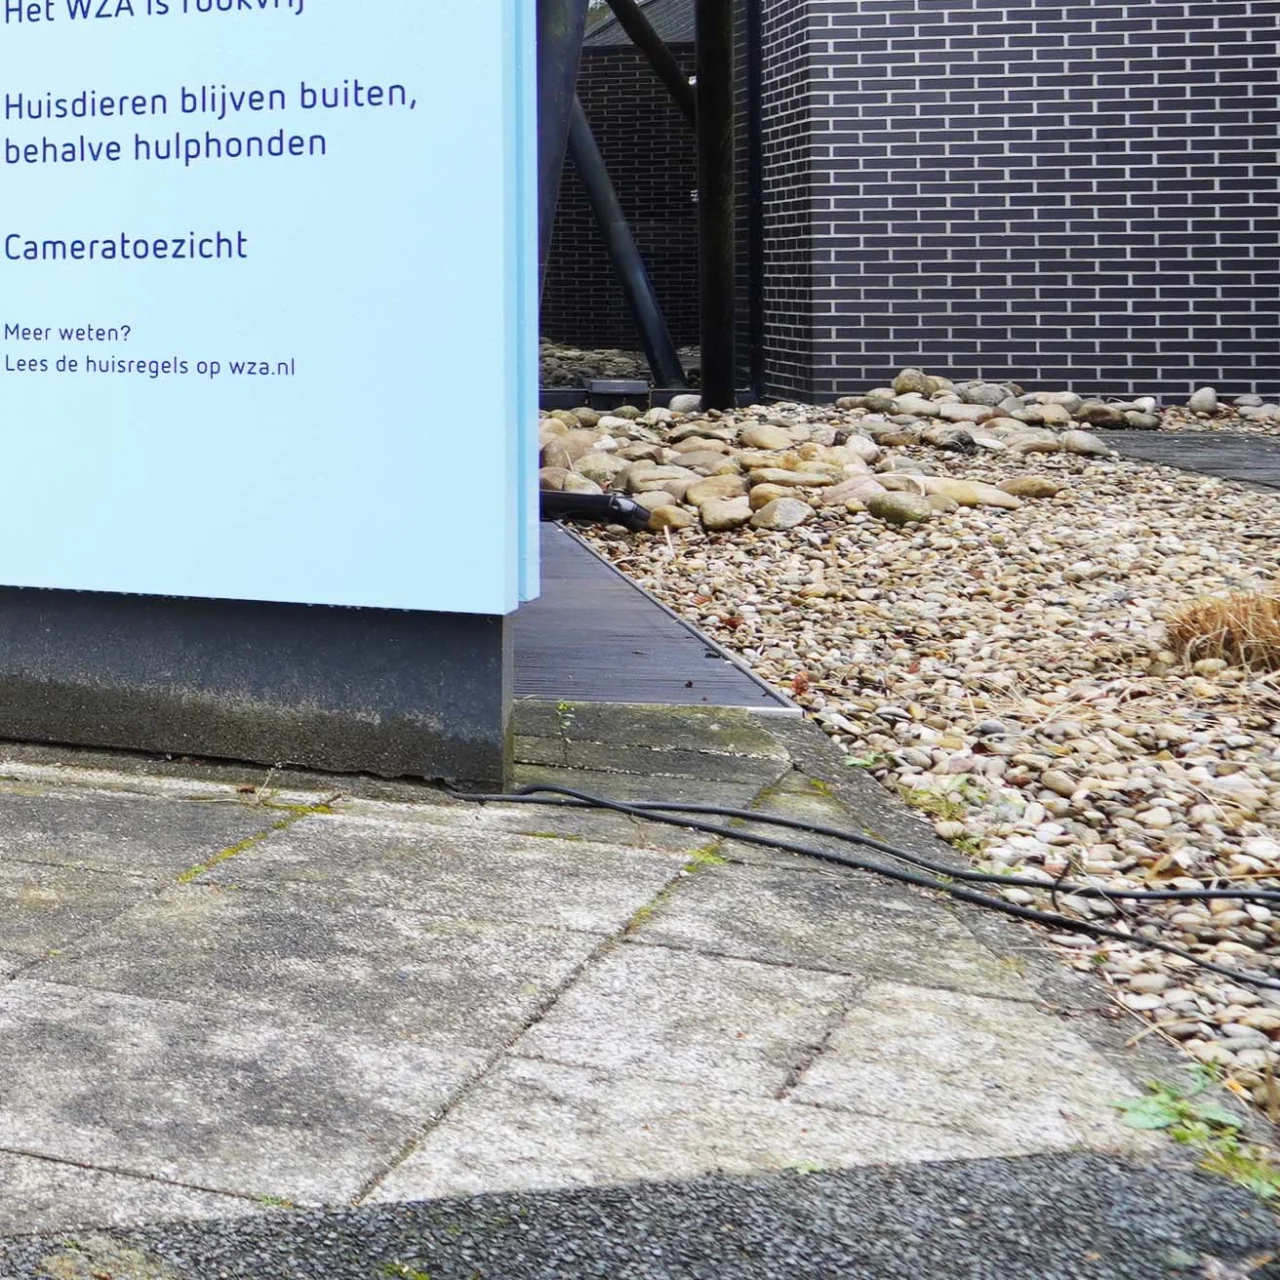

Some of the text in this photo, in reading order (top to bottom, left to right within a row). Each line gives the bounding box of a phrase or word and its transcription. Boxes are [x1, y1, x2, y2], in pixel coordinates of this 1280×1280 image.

[5, 79, 416, 121] Huisdieren blijven buiten,
[5, 128, 326, 167] behalve hulphonden
[5, 230, 248, 260] Cameratoezicht
[4, 323, 131, 342] Meer weten?
[5, 354, 295, 379] Lees de huisregels op wza.nl
